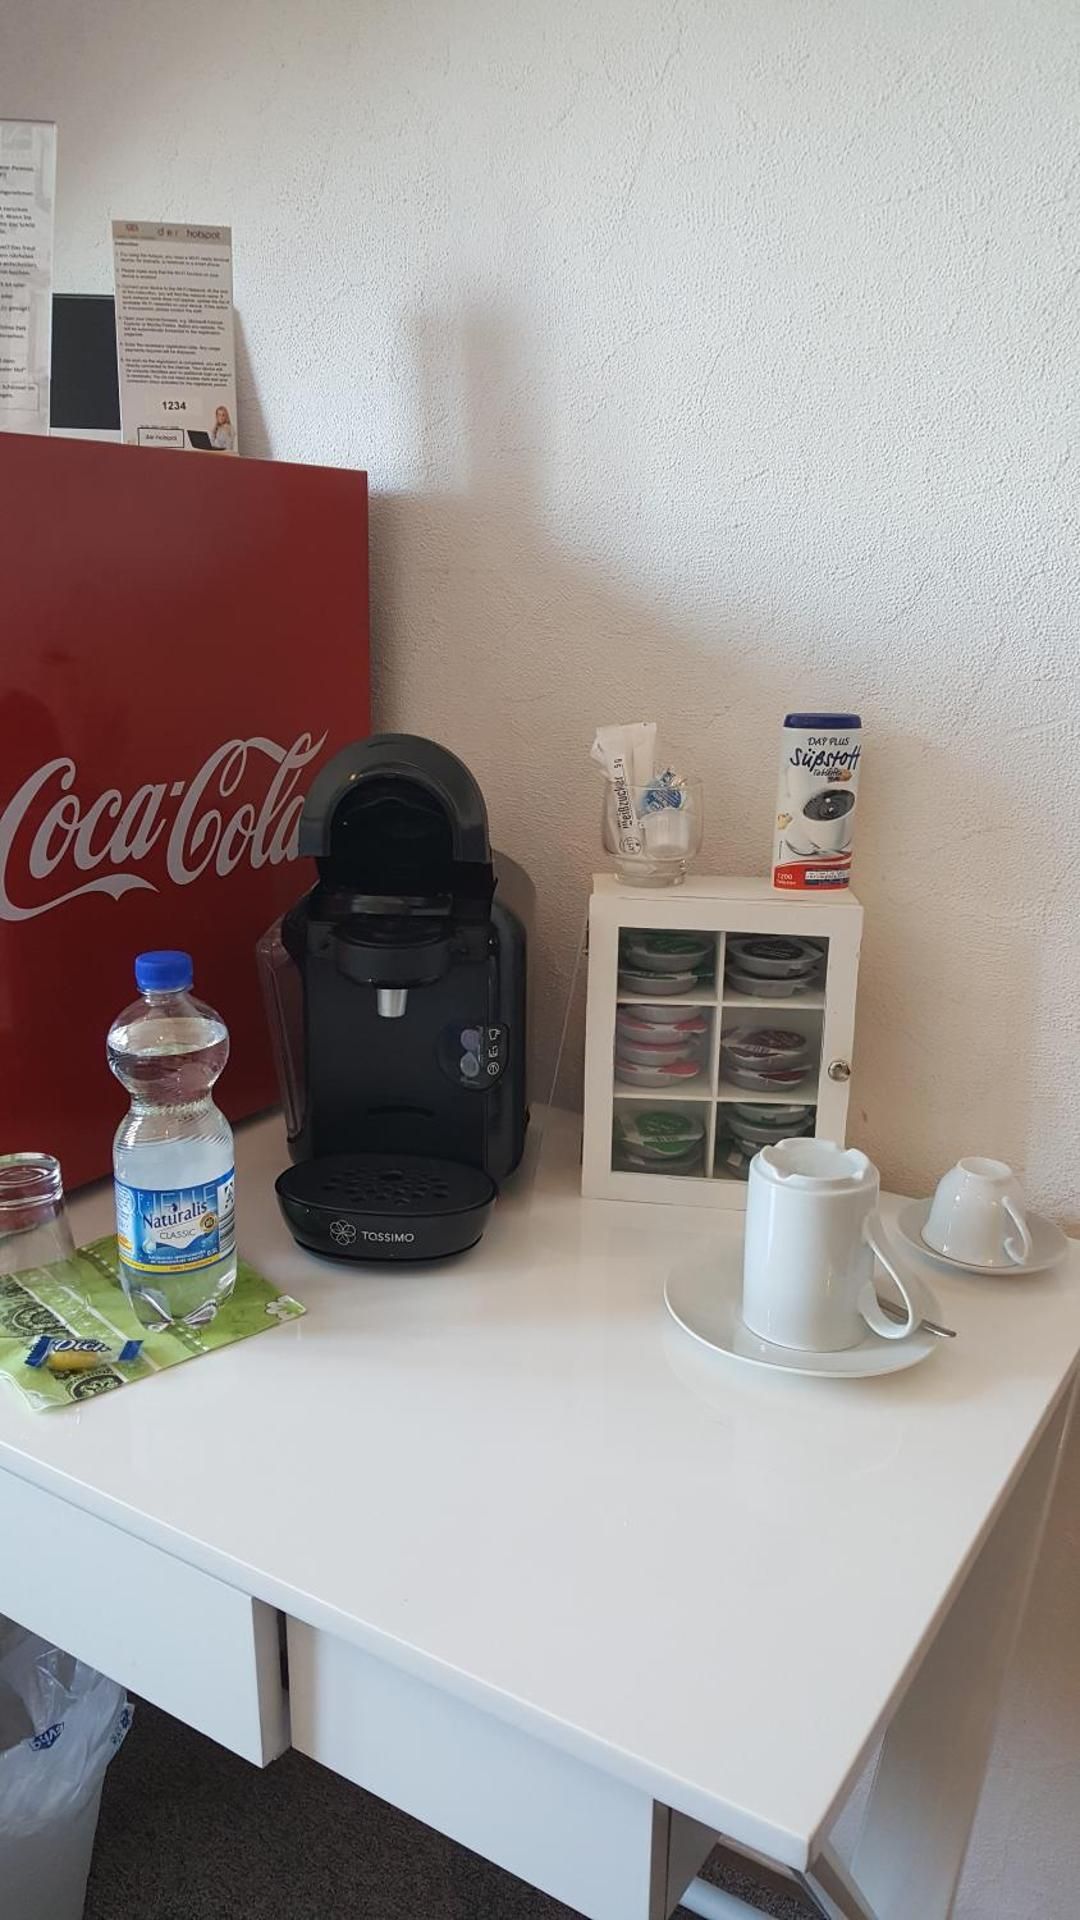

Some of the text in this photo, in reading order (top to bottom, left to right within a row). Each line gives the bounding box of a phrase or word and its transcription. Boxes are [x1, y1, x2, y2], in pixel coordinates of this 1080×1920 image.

[186, 228, 221, 240] hotspot
[162, 400, 187, 411] 1234
[807, 736, 850, 747] DAY PLUS
[0, 729, 329, 921] Coca-Cola
[143, 1201, 208, 1229] Naturalis
[159, 1229, 196, 1240] CLASSIC
